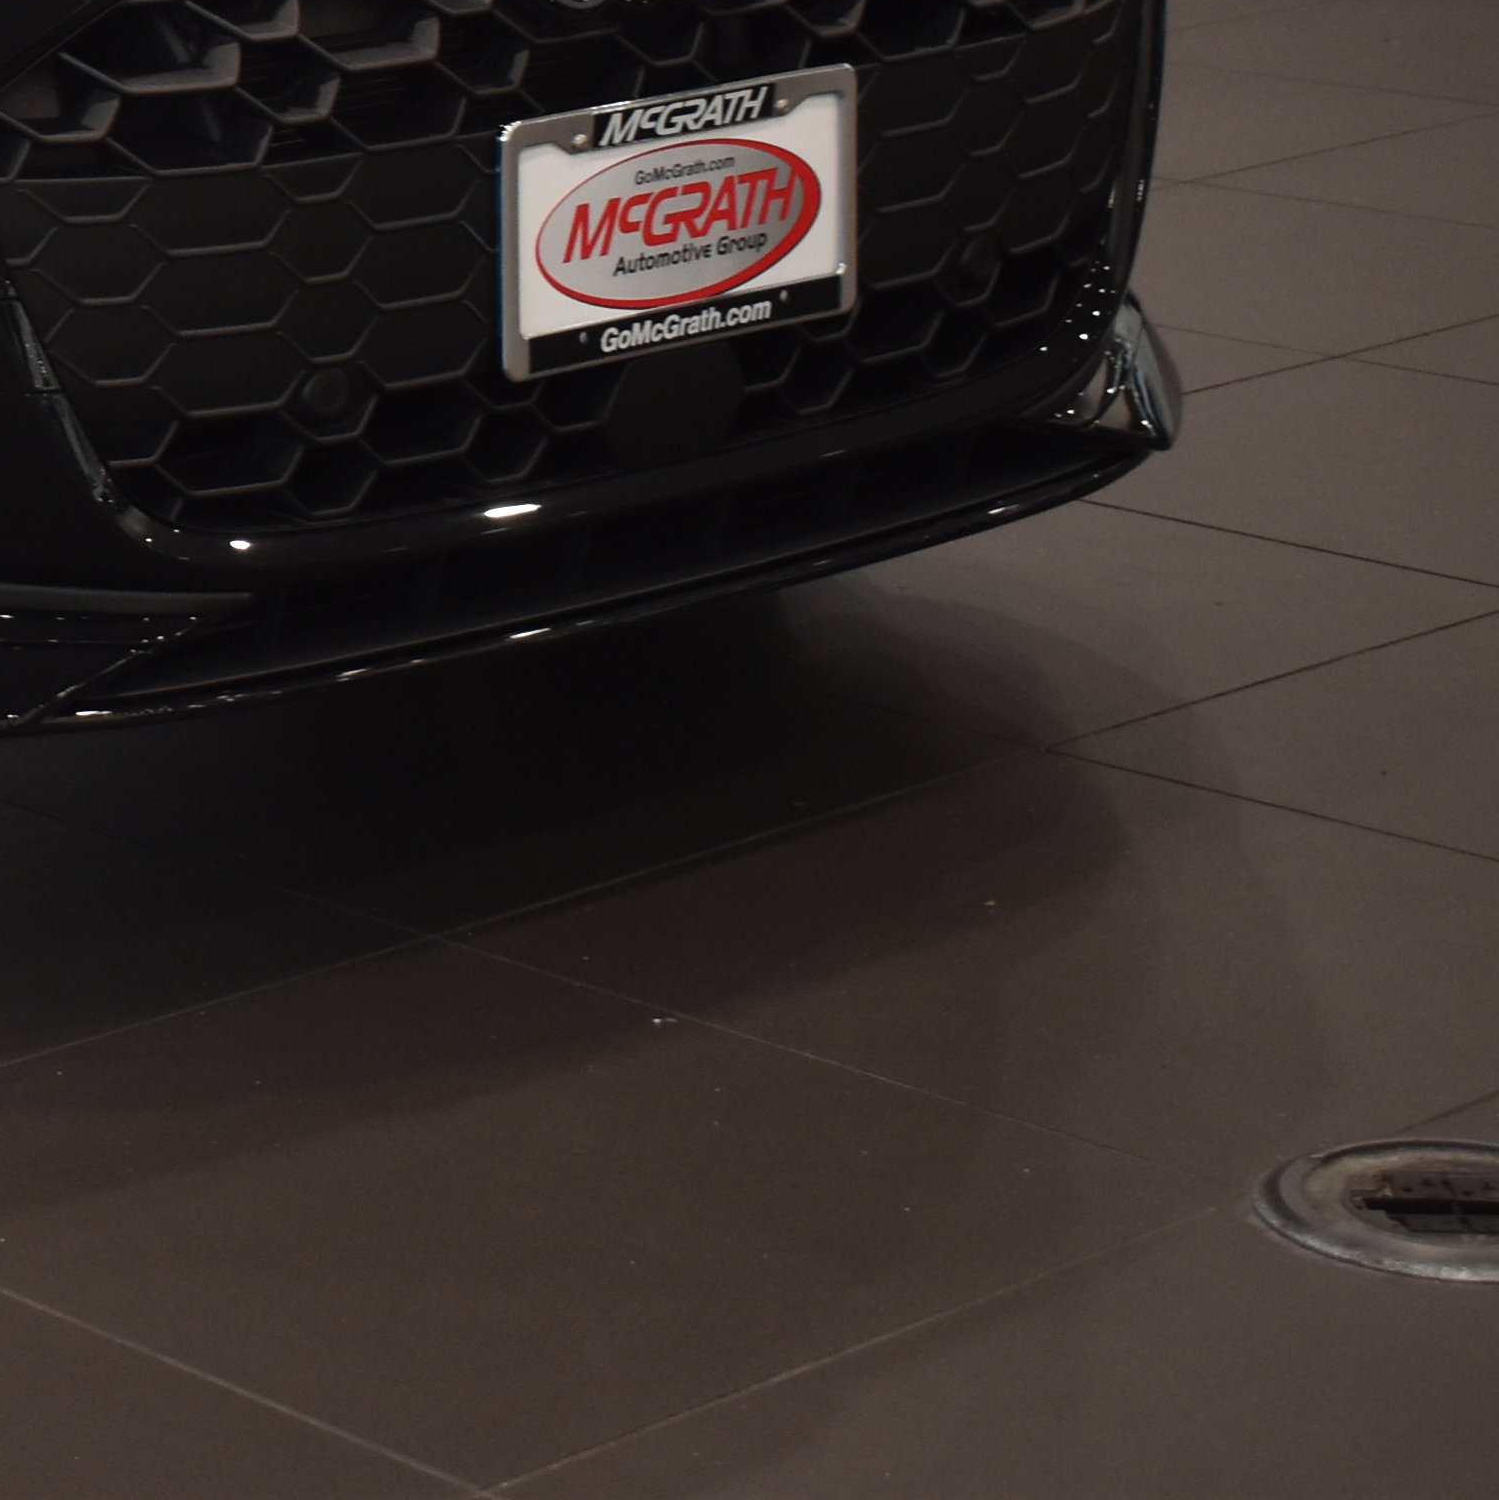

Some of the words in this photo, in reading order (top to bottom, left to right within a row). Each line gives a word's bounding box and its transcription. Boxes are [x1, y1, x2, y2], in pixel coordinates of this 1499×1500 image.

[634, 155, 736, 186] GoMcGrath.com
[612, 243, 712, 277] Automotive
[716, 231, 767, 257] Group
[600, 298, 771, 353] GoMcGrath.com
